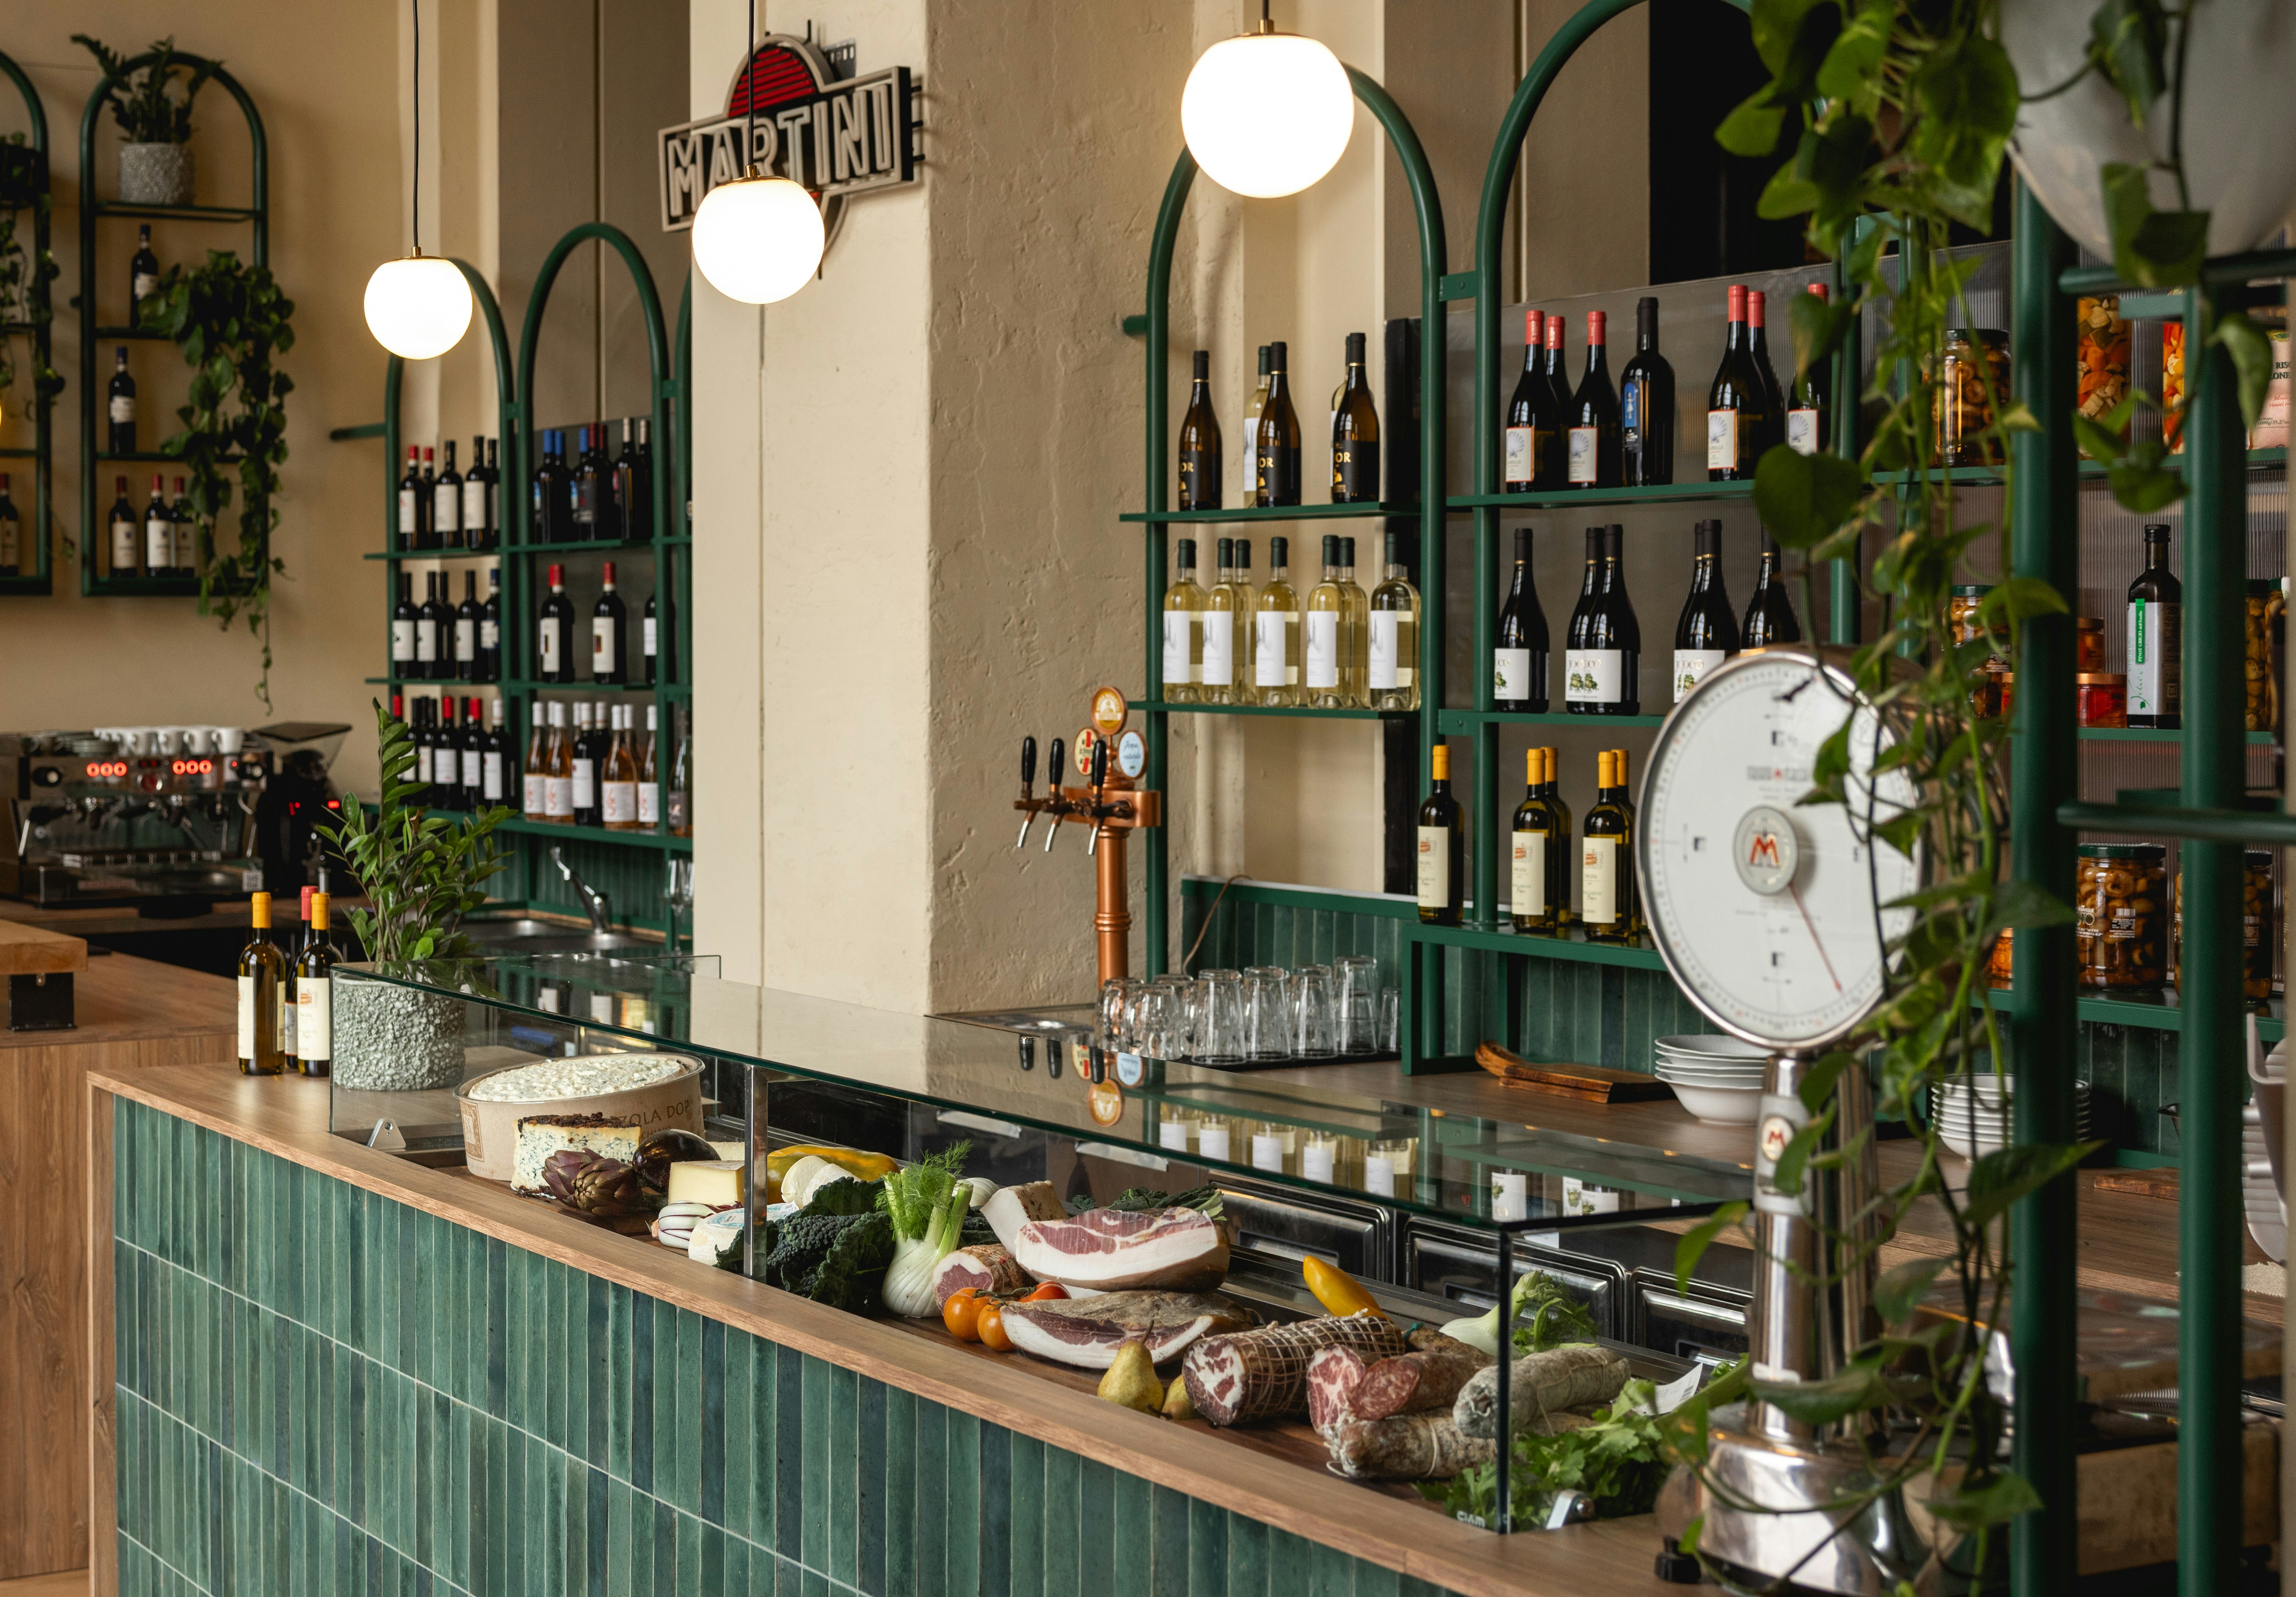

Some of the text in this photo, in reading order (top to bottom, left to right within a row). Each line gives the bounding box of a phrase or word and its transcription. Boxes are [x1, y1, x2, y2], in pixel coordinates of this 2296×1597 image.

[667, 84, 891, 217] MARTINI
[2275, 361, 2290, 369] RIS
[667, 1100, 689, 1119] DOP
